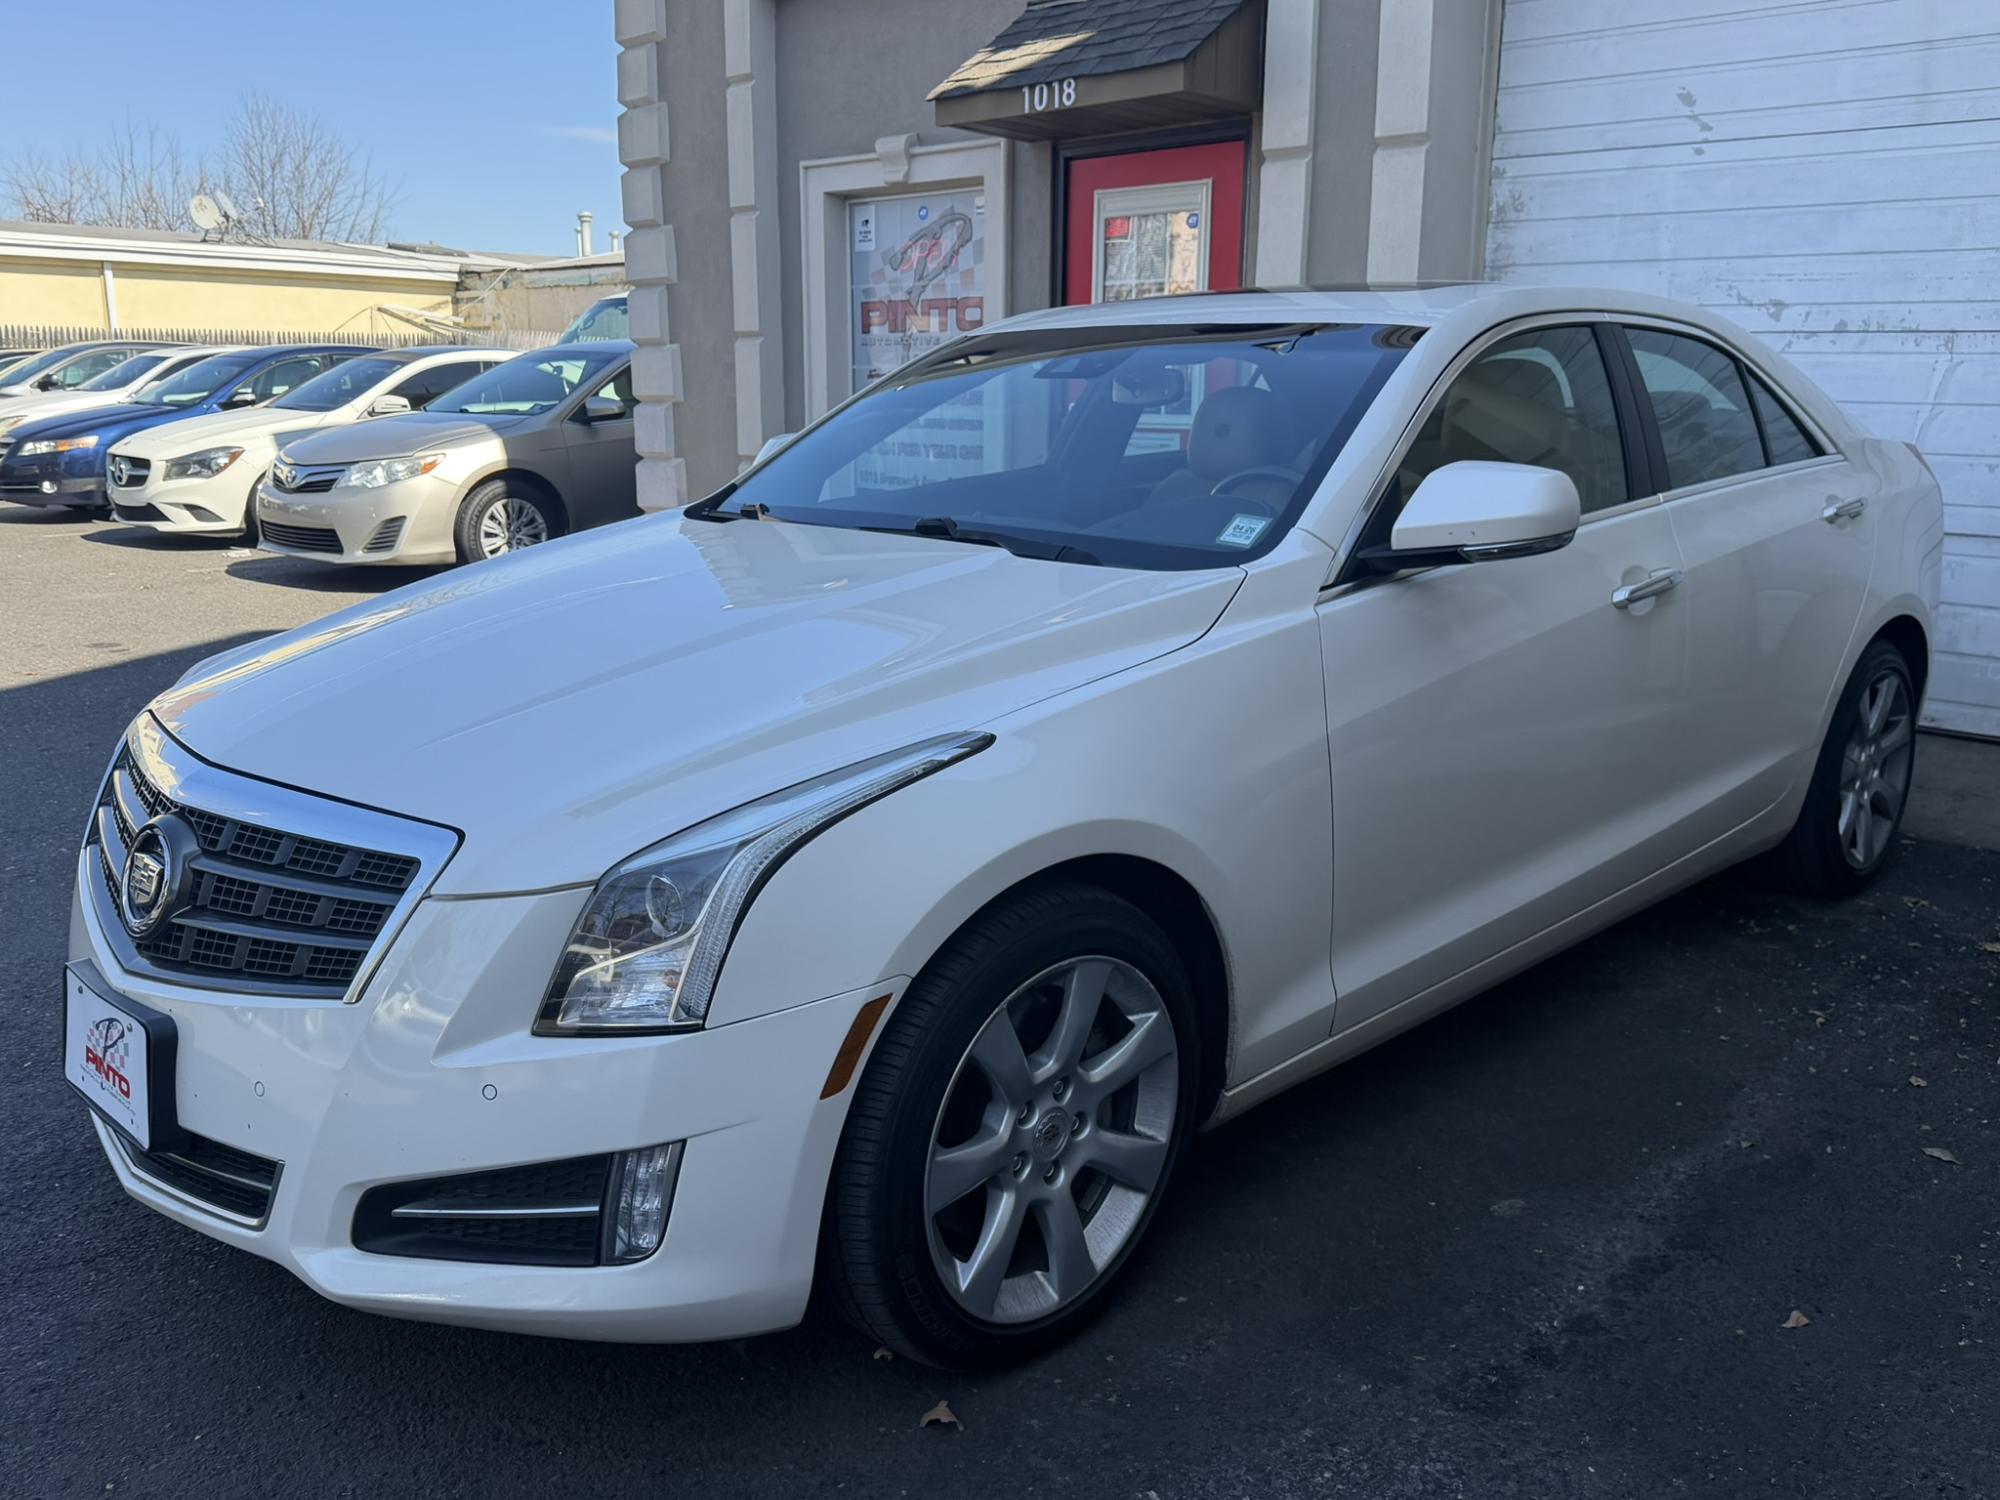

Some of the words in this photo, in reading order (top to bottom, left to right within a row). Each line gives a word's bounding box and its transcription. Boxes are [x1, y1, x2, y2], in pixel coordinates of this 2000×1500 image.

[1022, 78, 1076, 114] 1018
[861, 297, 984, 334] PINTO
[85, 1045, 131, 1100] PINTO
